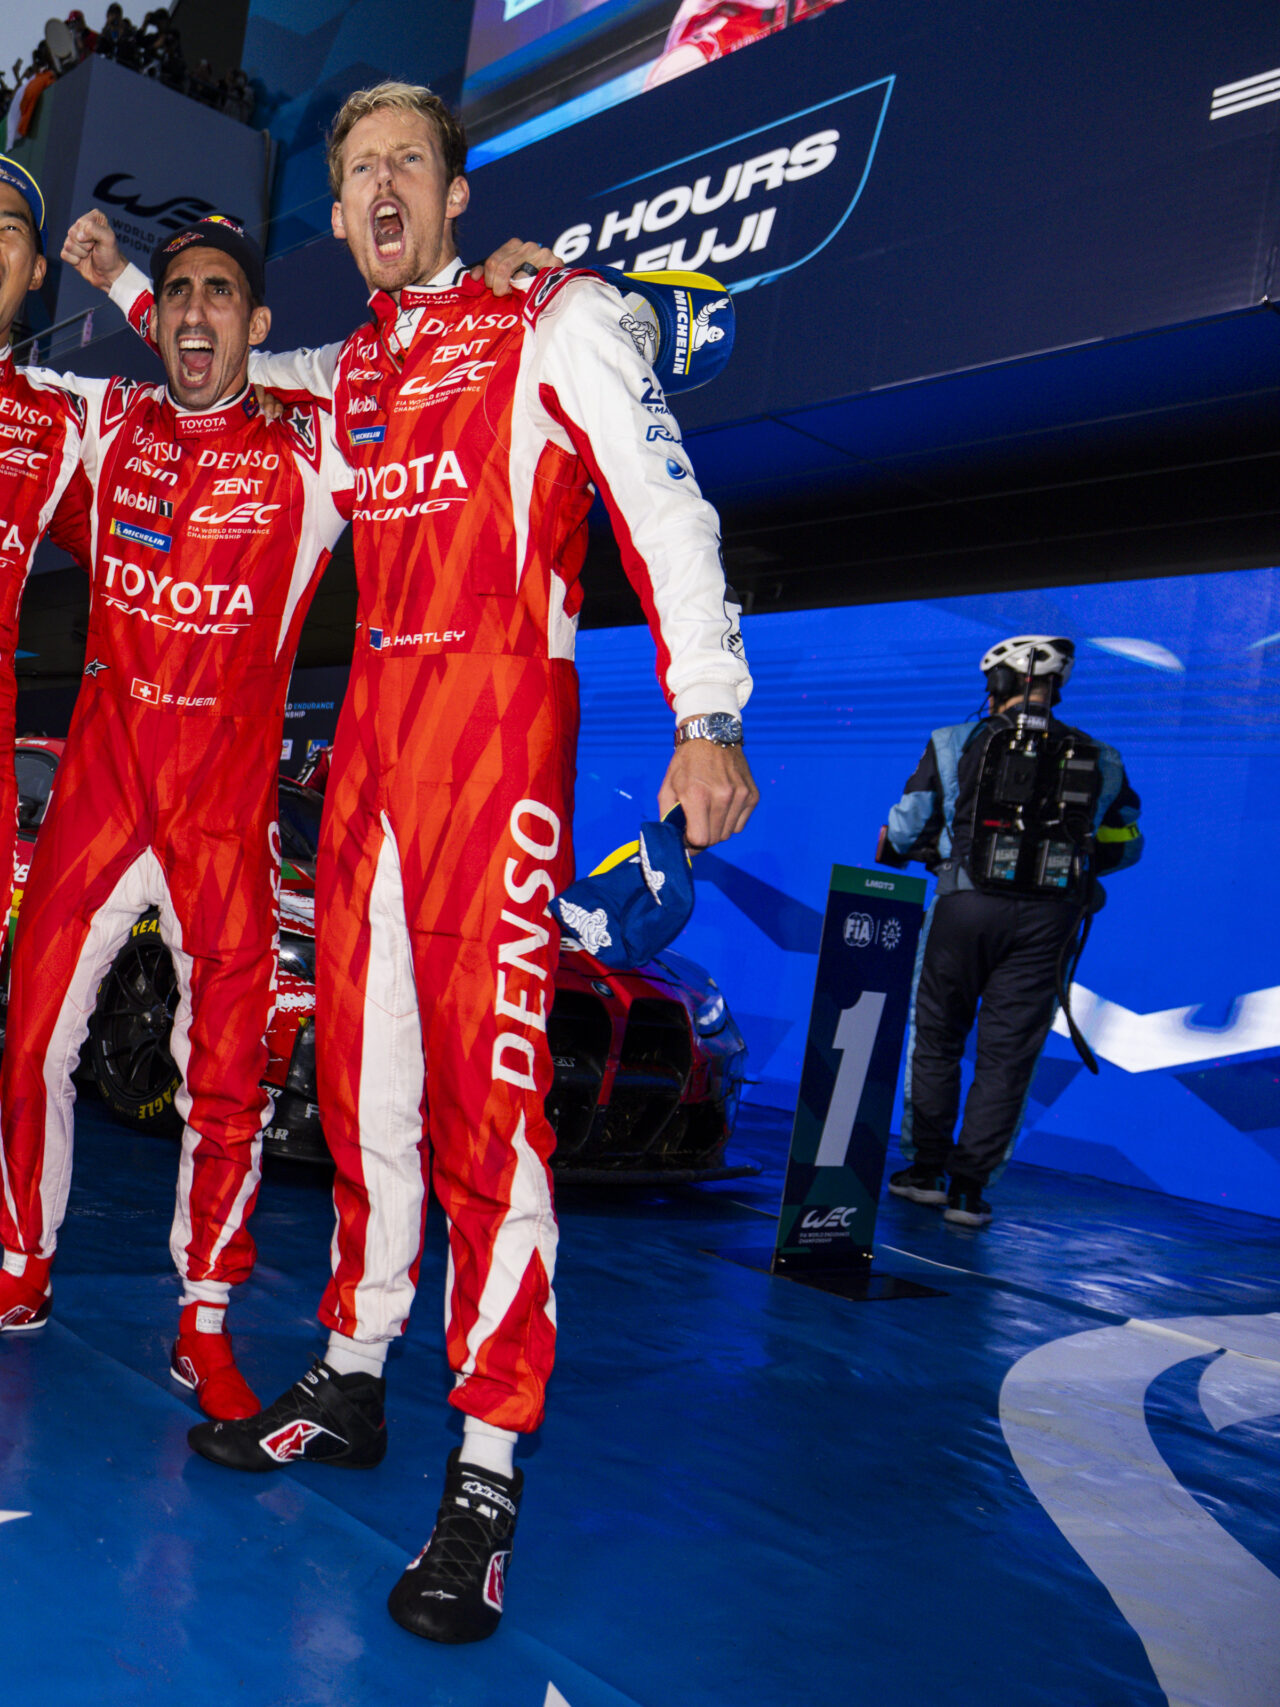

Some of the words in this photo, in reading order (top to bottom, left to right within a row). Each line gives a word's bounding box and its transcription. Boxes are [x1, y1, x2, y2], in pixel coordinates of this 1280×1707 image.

[553, 223, 592, 264] 6
[596, 129, 840, 251] HOURS
[632, 206, 777, 272] FUJI
[672, 290, 686, 375] MICHELIN
[430, 338, 491, 365] ZENT
[398, 360, 498, 396] WEC
[180, 417, 227, 430] TOYOTA
[197, 449, 280, 471] DENSO
[211, 478, 264, 496] ZENT
[355, 450, 469, 503] OYOTA
[113, 485, 157, 514] Mobil
[189, 502, 282, 525] WEC
[122, 528, 166, 547] MICHELIN
[187, 525, 200, 533] FIA
[187, 531, 241, 540] CHAMPIONSHIP
[102, 555, 254, 616] TOYOTA
[99, 593, 252, 635] RACING
[176, 695, 217, 706] BUEMI
[293, 702, 336, 710] ENDURANCE
[864, 879, 896, 892] LMGT3
[491, 799, 561, 1092] DENSO
[814, 990, 888, 1167] 1
[801, 1206, 858, 1228] WEC
